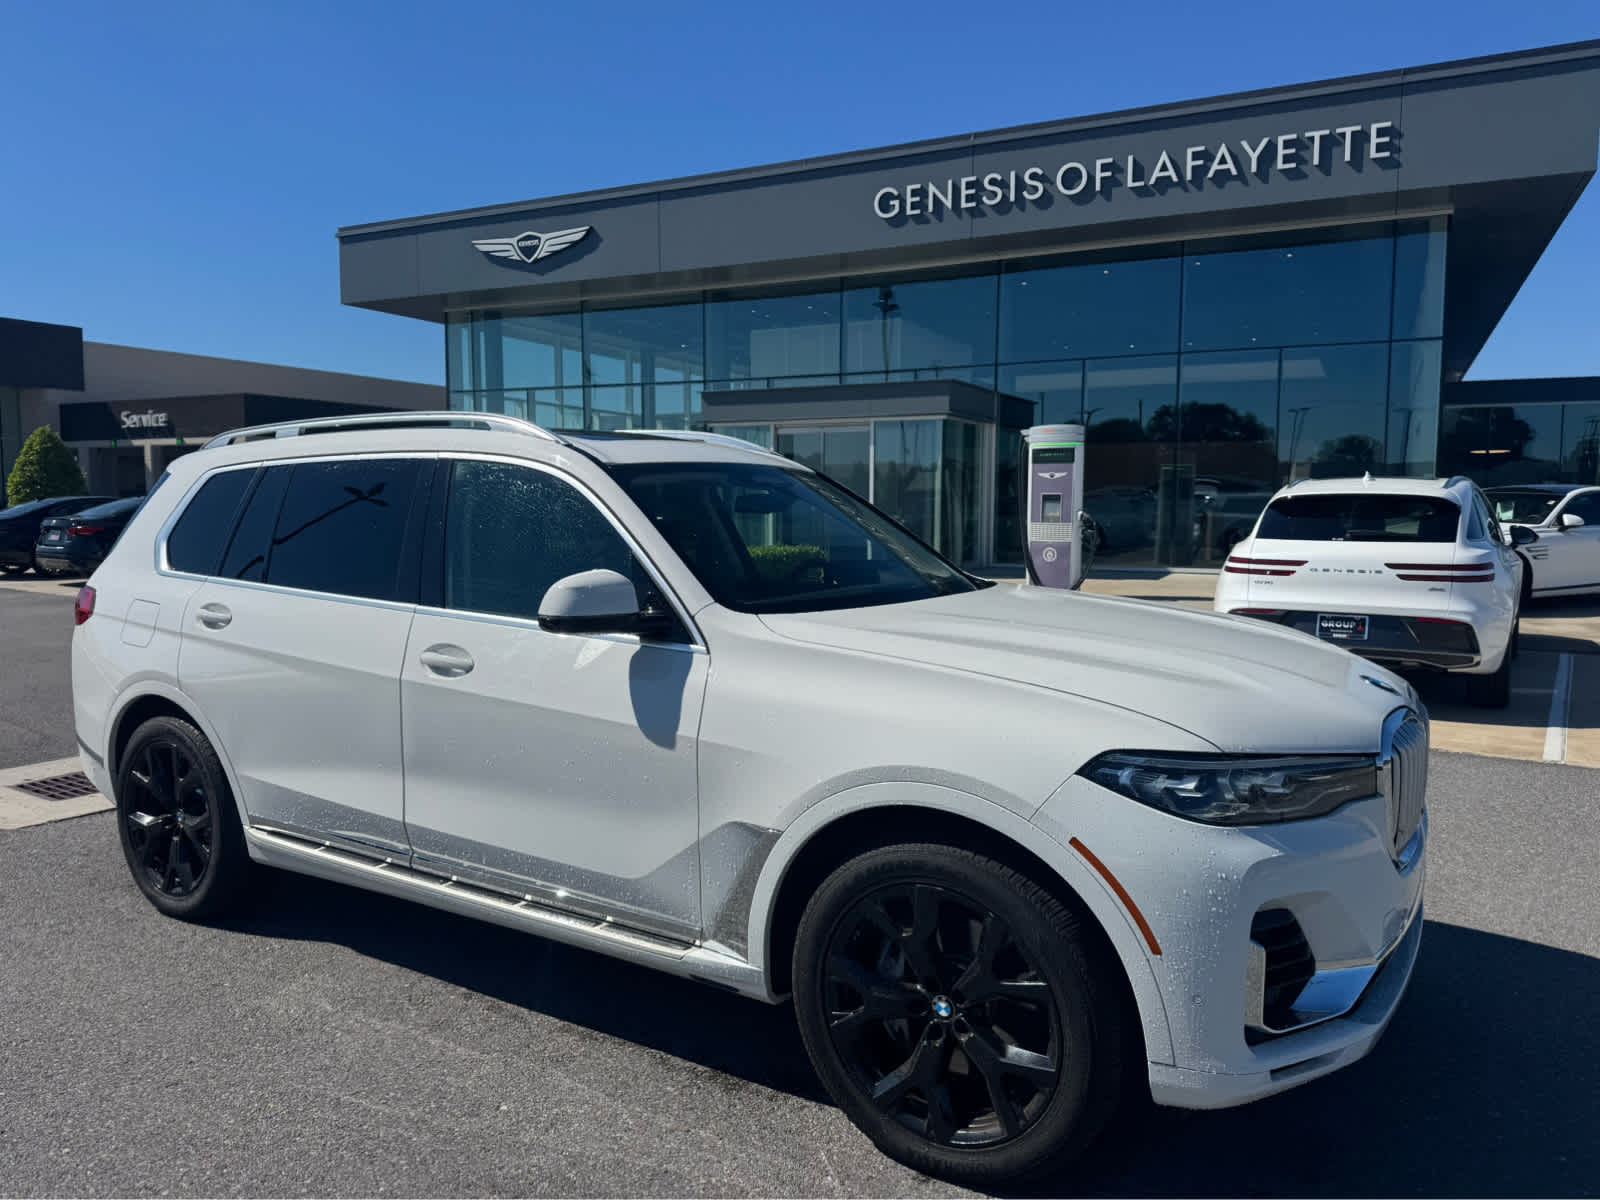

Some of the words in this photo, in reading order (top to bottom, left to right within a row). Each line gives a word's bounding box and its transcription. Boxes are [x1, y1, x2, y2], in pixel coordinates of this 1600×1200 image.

[874, 166, 1046, 219] GENESIS
[1056, 157, 1113, 196] OF
[1127, 121, 1393, 188] LAFAYETTE
[121, 410, 167, 428] Service
